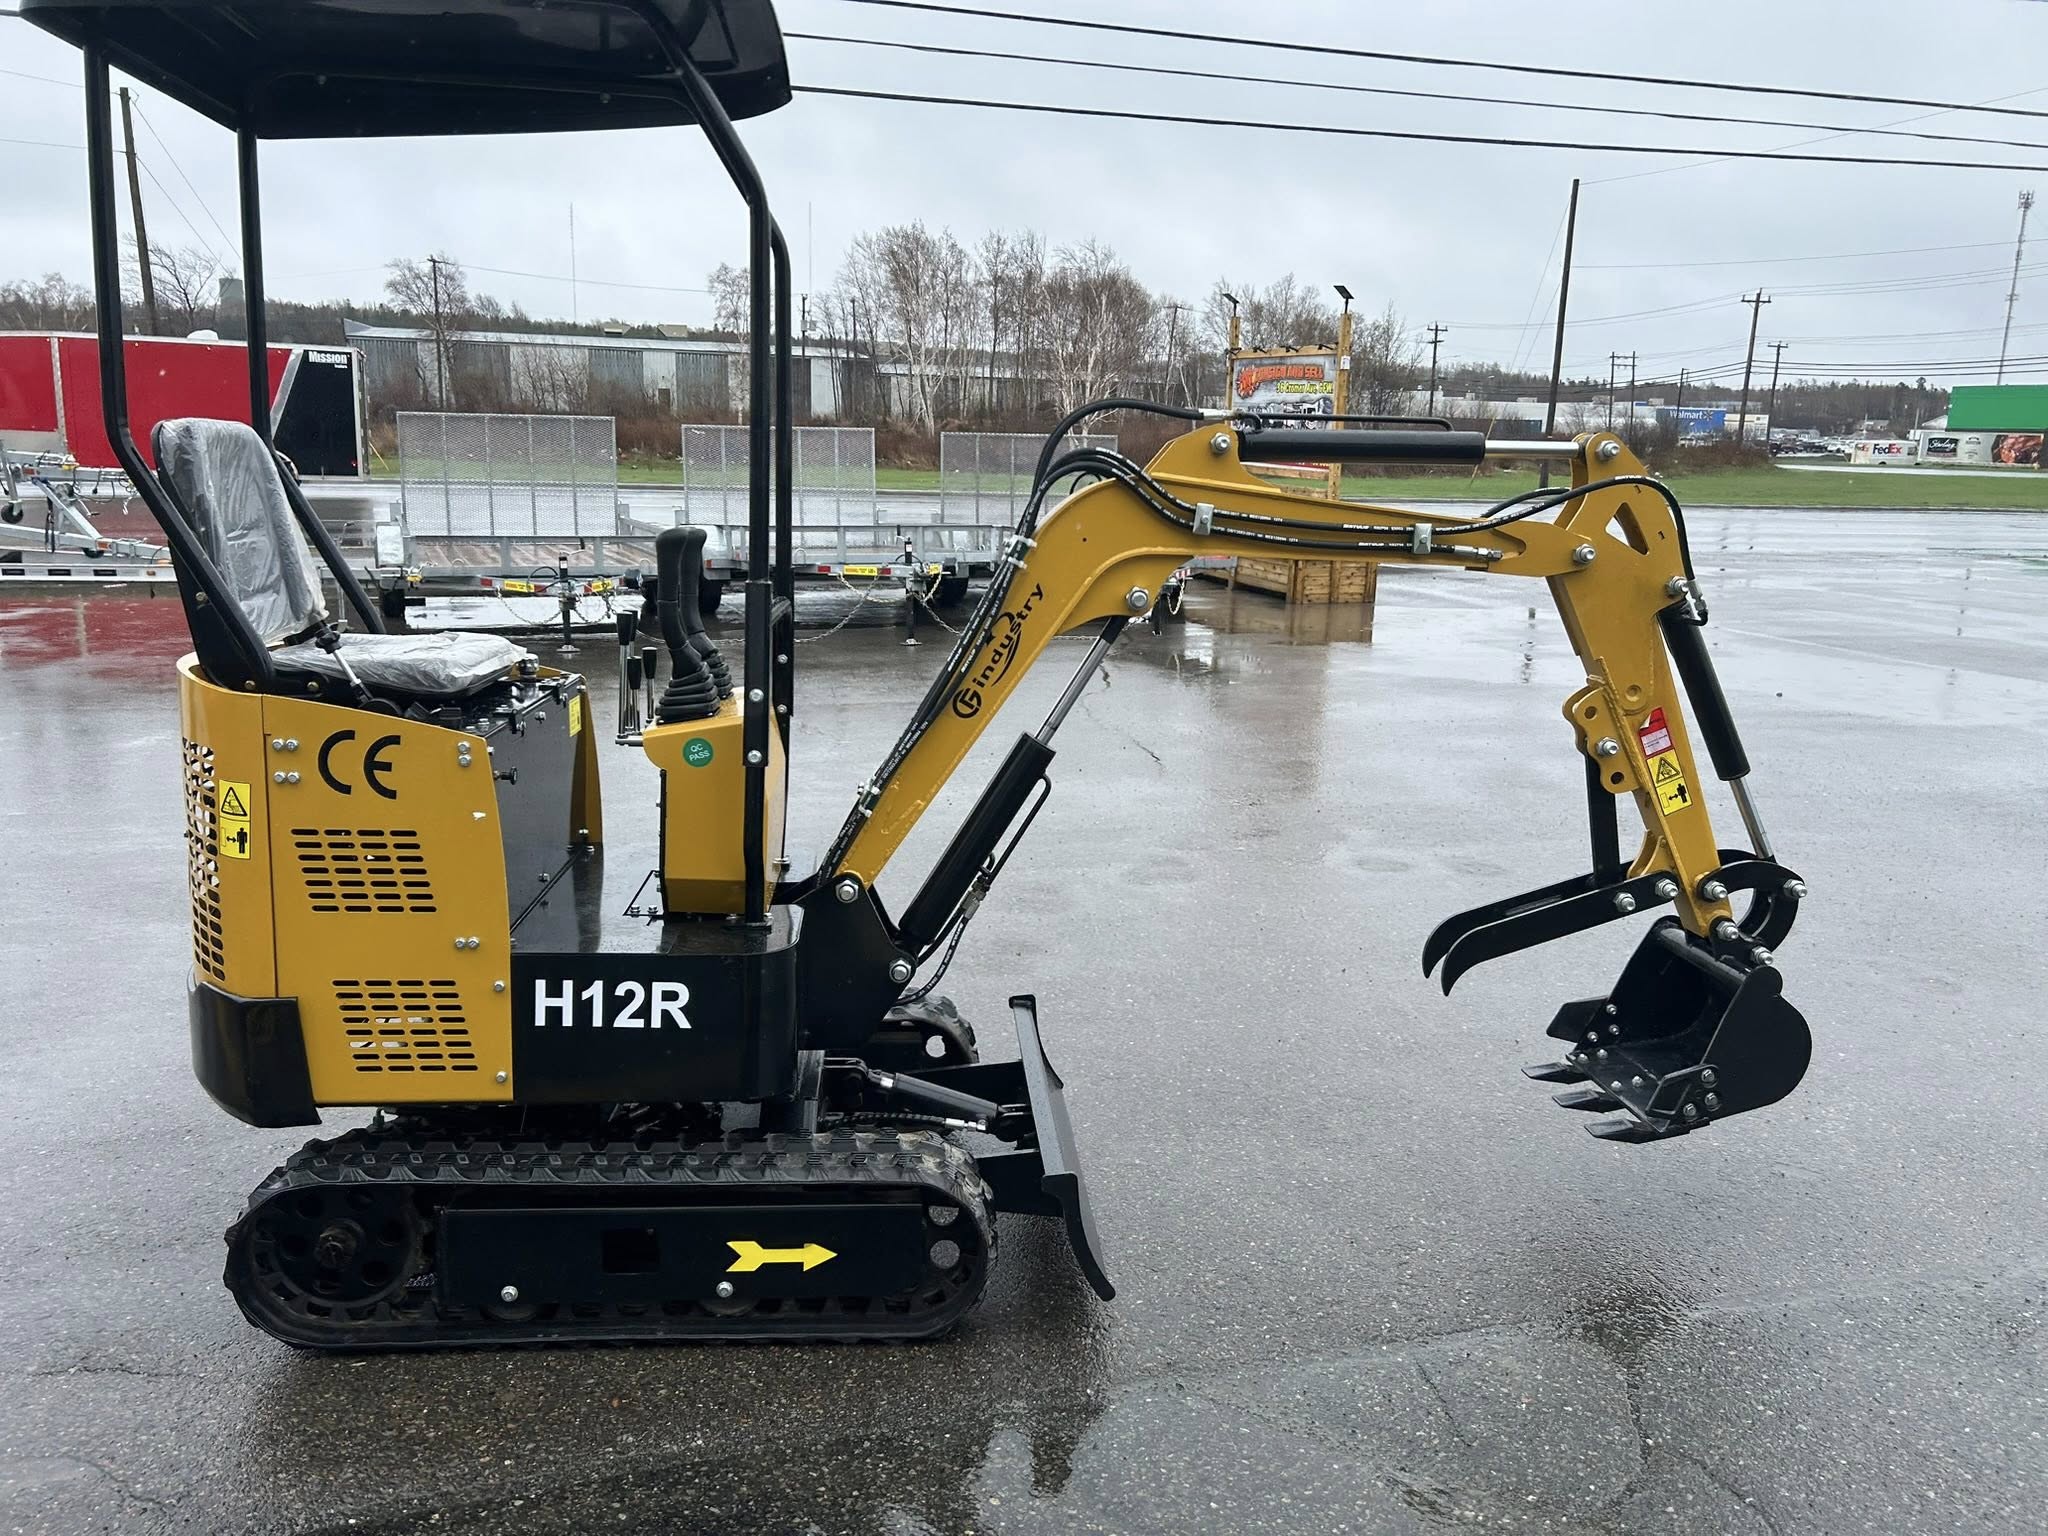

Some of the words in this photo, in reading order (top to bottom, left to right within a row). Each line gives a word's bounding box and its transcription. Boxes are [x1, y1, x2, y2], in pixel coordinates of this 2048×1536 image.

[1670, 410, 1702, 419] Walmart
[1872, 443, 1903, 454] FedEx
[690, 743, 703, 752] QC
[689, 750, 710, 761] PASS
[318, 730, 401, 800] CE
[535, 979, 692, 1029] H12R
